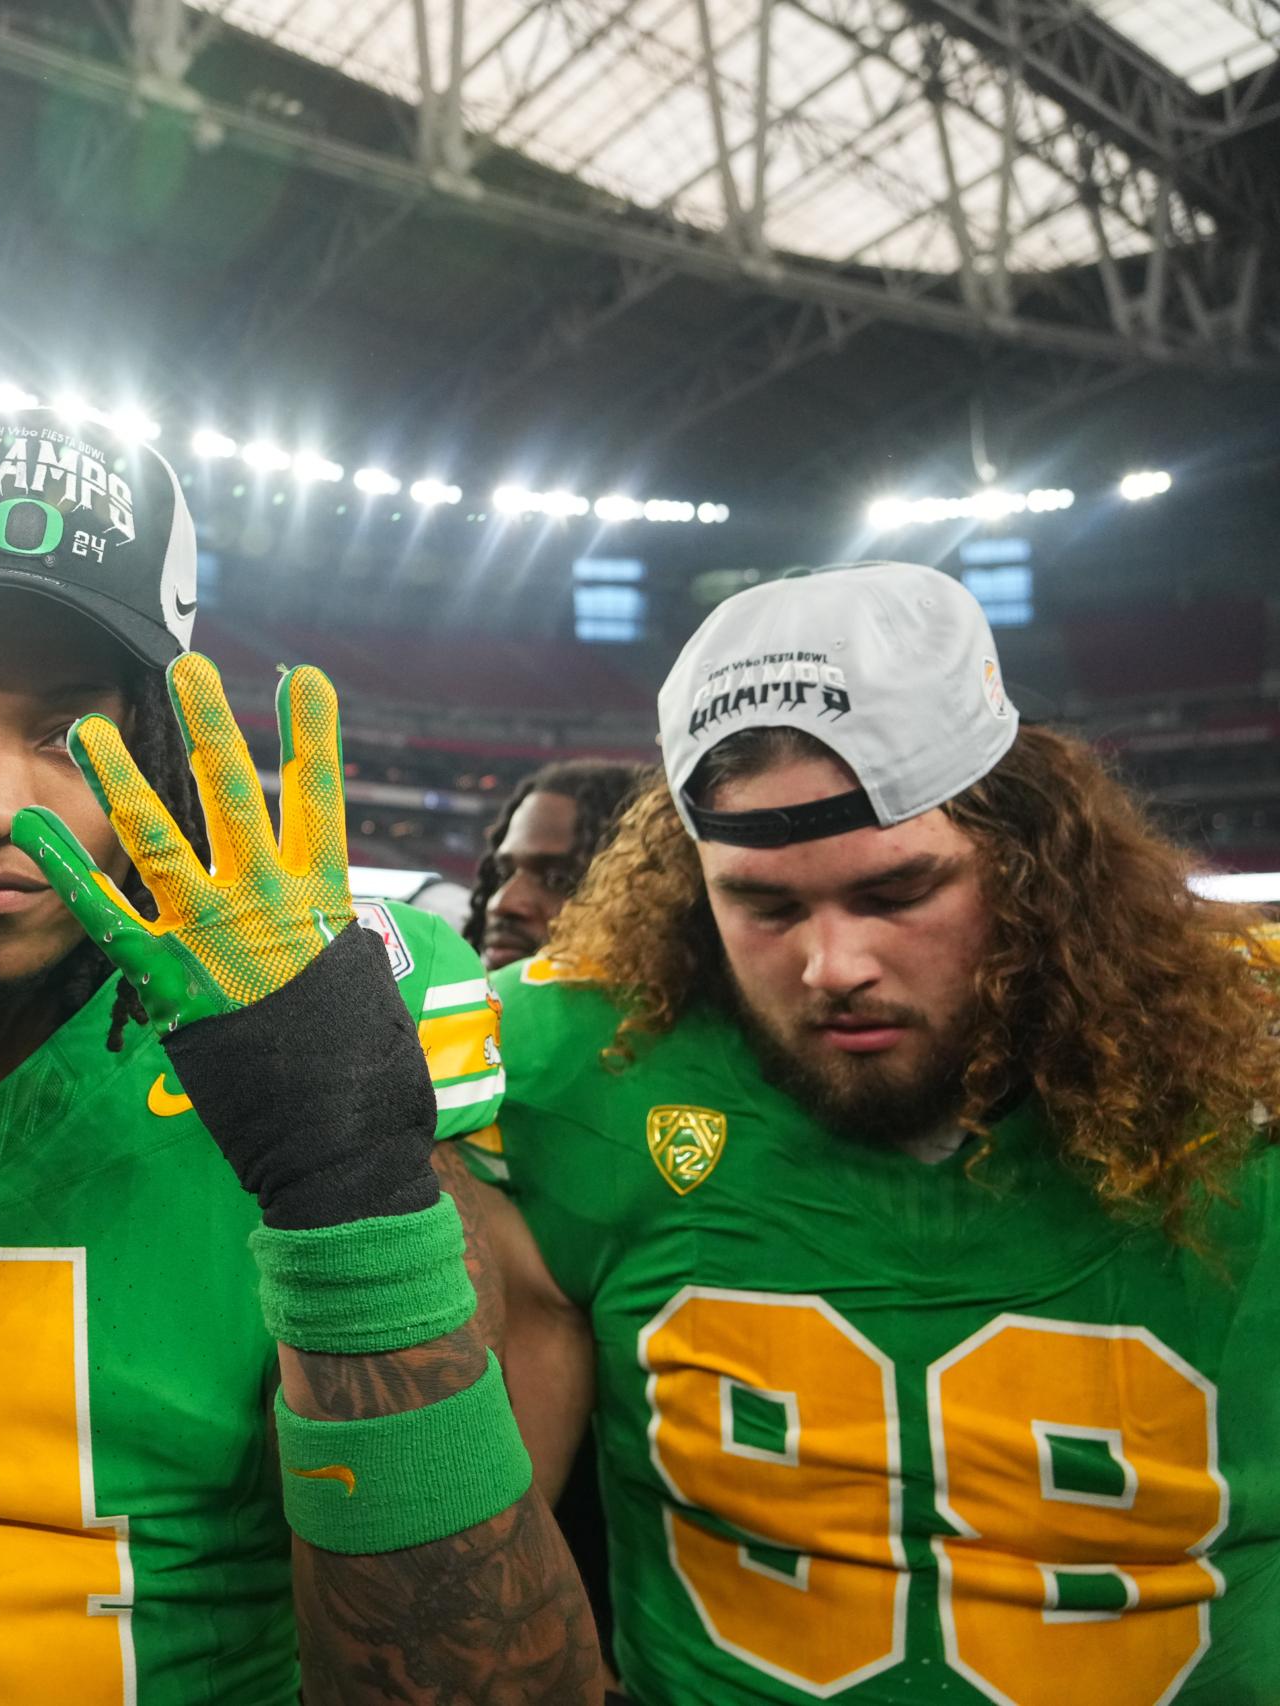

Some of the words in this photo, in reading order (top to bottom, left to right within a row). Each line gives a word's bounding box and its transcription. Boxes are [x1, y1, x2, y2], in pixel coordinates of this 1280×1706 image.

[40, 428, 76, 449] FIESTA
[72, 530, 107, 564] 24
[796, 651, 829, 664] BOWL
[688, 661, 852, 741] CHAMPS
[651, 1110, 721, 1158] PAC
[665, 1144, 702, 1177] 12
[637, 1284, 1231, 1706] 98
